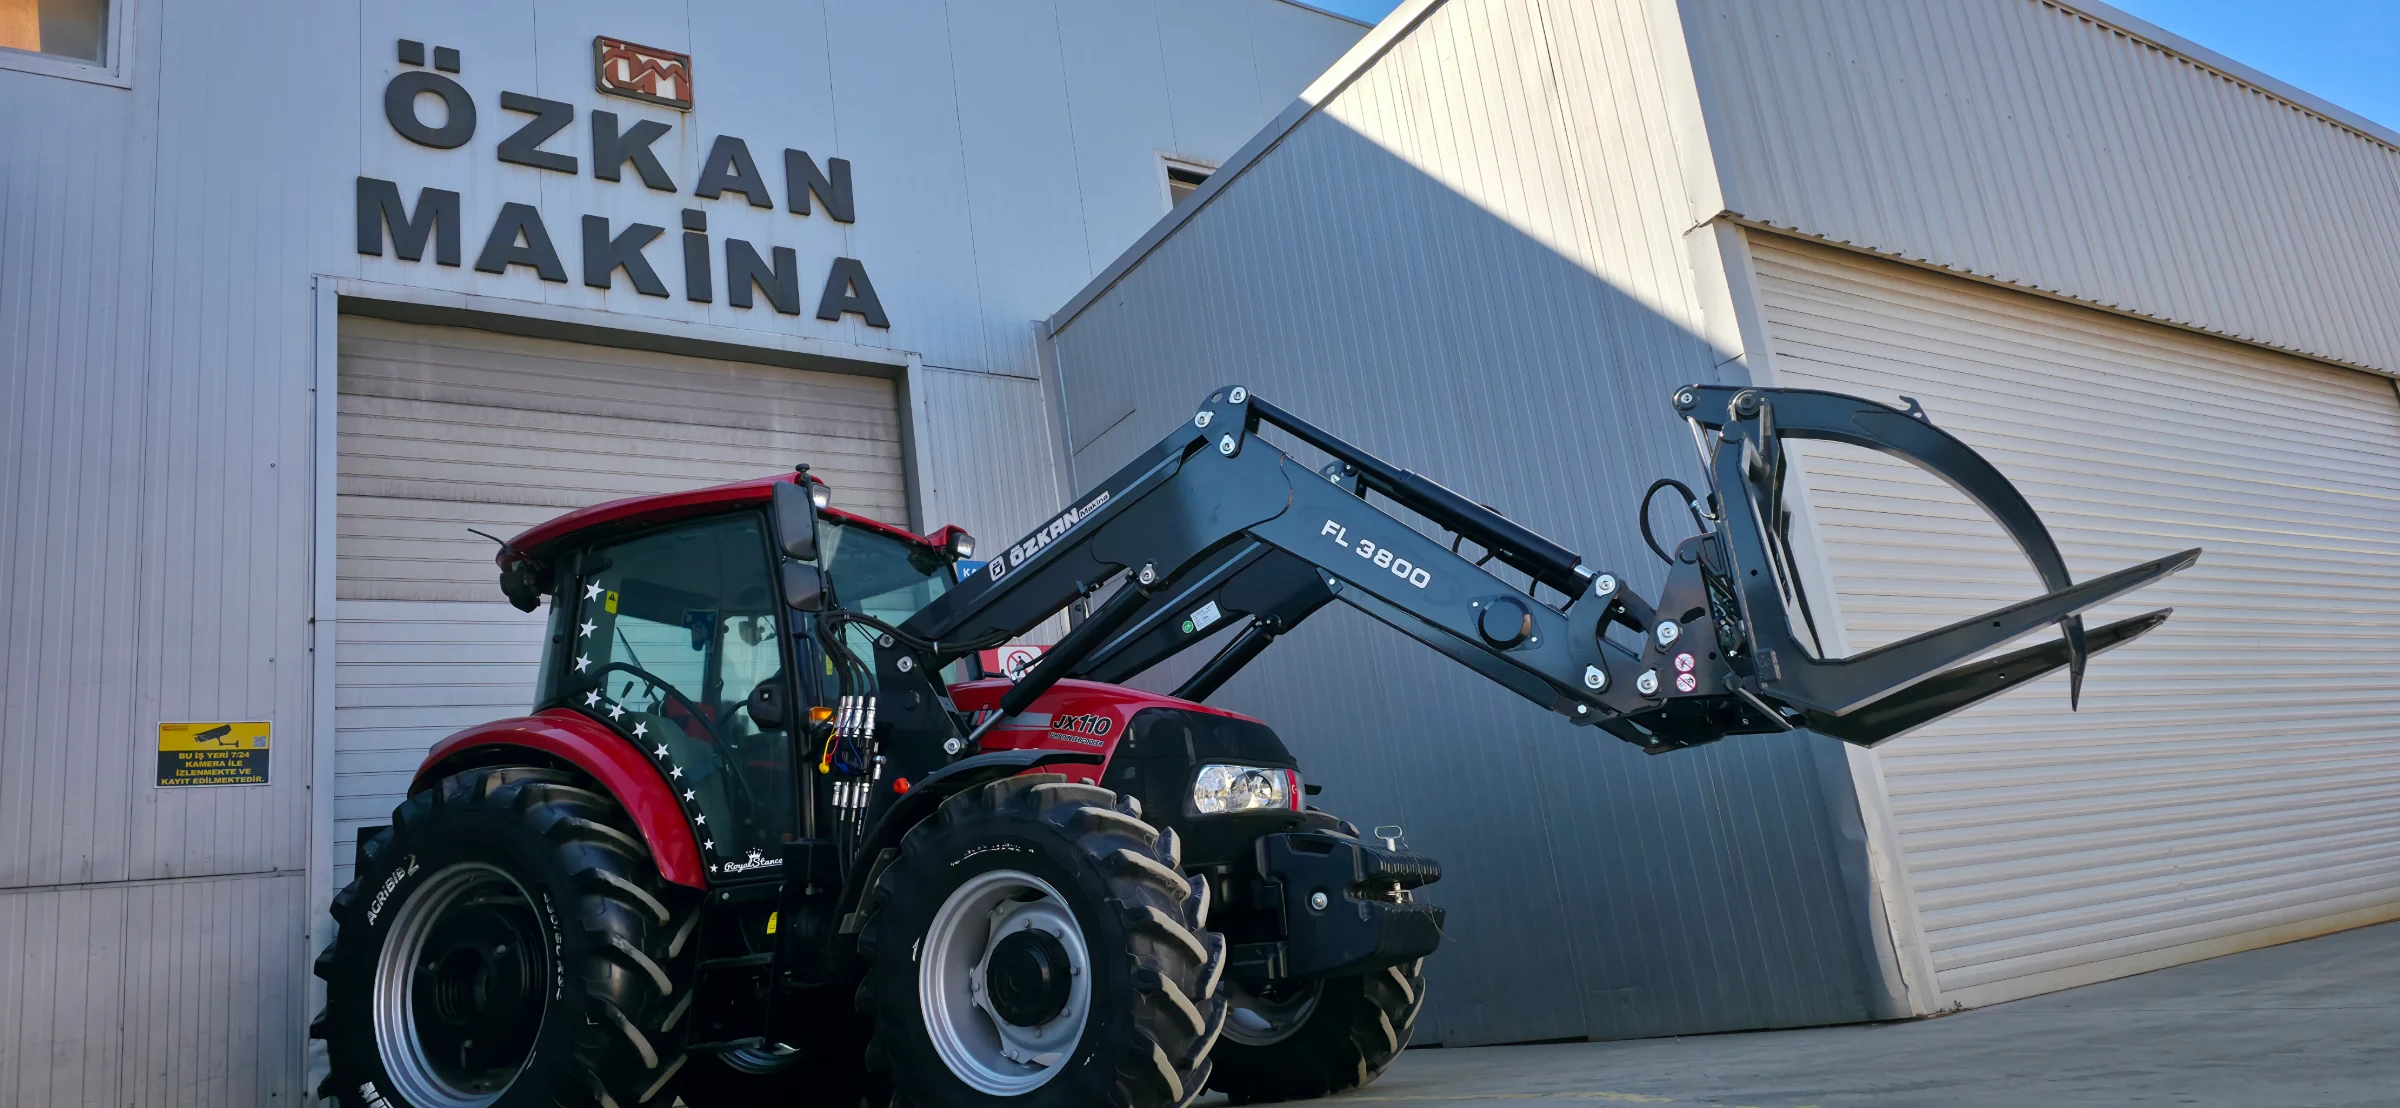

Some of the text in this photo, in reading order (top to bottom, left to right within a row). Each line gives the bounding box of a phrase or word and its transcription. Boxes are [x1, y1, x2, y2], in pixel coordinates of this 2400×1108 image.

[384, 39, 855, 223] ÖZKAN
[357, 176, 890, 329] MAKİNA
[1009, 507, 1080, 567] ÖZKAN
[1080, 492, 1109, 518] Makina
[1321, 519, 1431, 589] FL 3800
[1052, 713, 1112, 736] JX110
[175, 768, 237, 777] İZLENMEKTE
[178, 751, 250, 760] BU İŞ YERİ 7/24
[185, 759, 243, 768] KAMERA İLE
[192, 775, 265, 785] EDİLMEKTEDİR.
[367, 853, 420, 926] AGRIBIB 2
